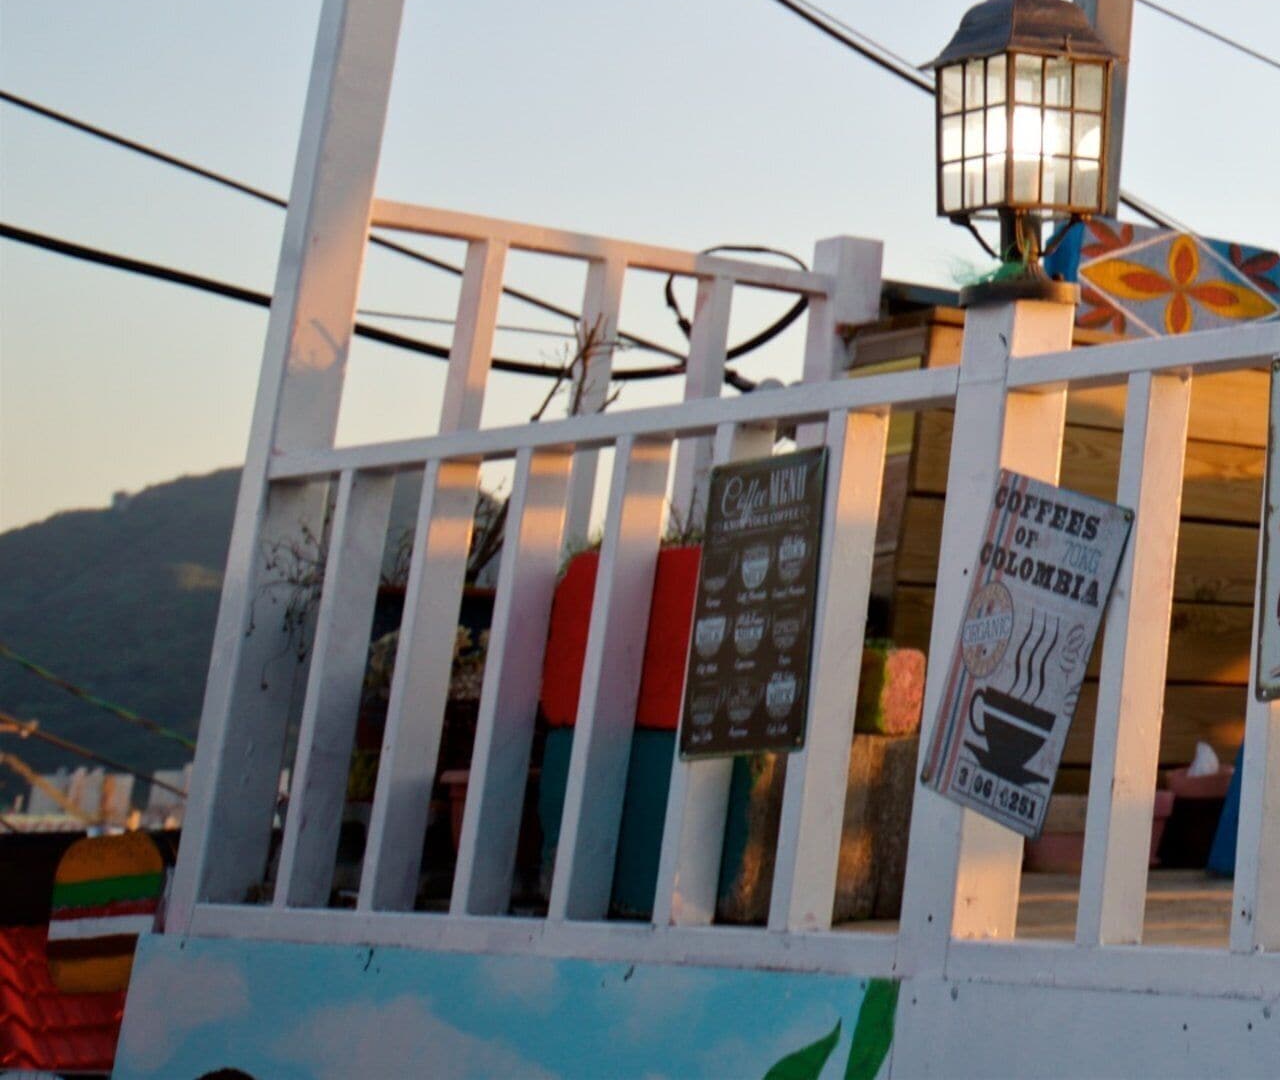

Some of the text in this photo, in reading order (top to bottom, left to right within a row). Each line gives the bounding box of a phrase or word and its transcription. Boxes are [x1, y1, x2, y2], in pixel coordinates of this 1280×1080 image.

[768, 465, 807, 507] MENU
[995, 485, 1100, 541] COFFEES
[1015, 526, 1039, 549] OF
[980, 542, 1100, 608] COLOMBIA
